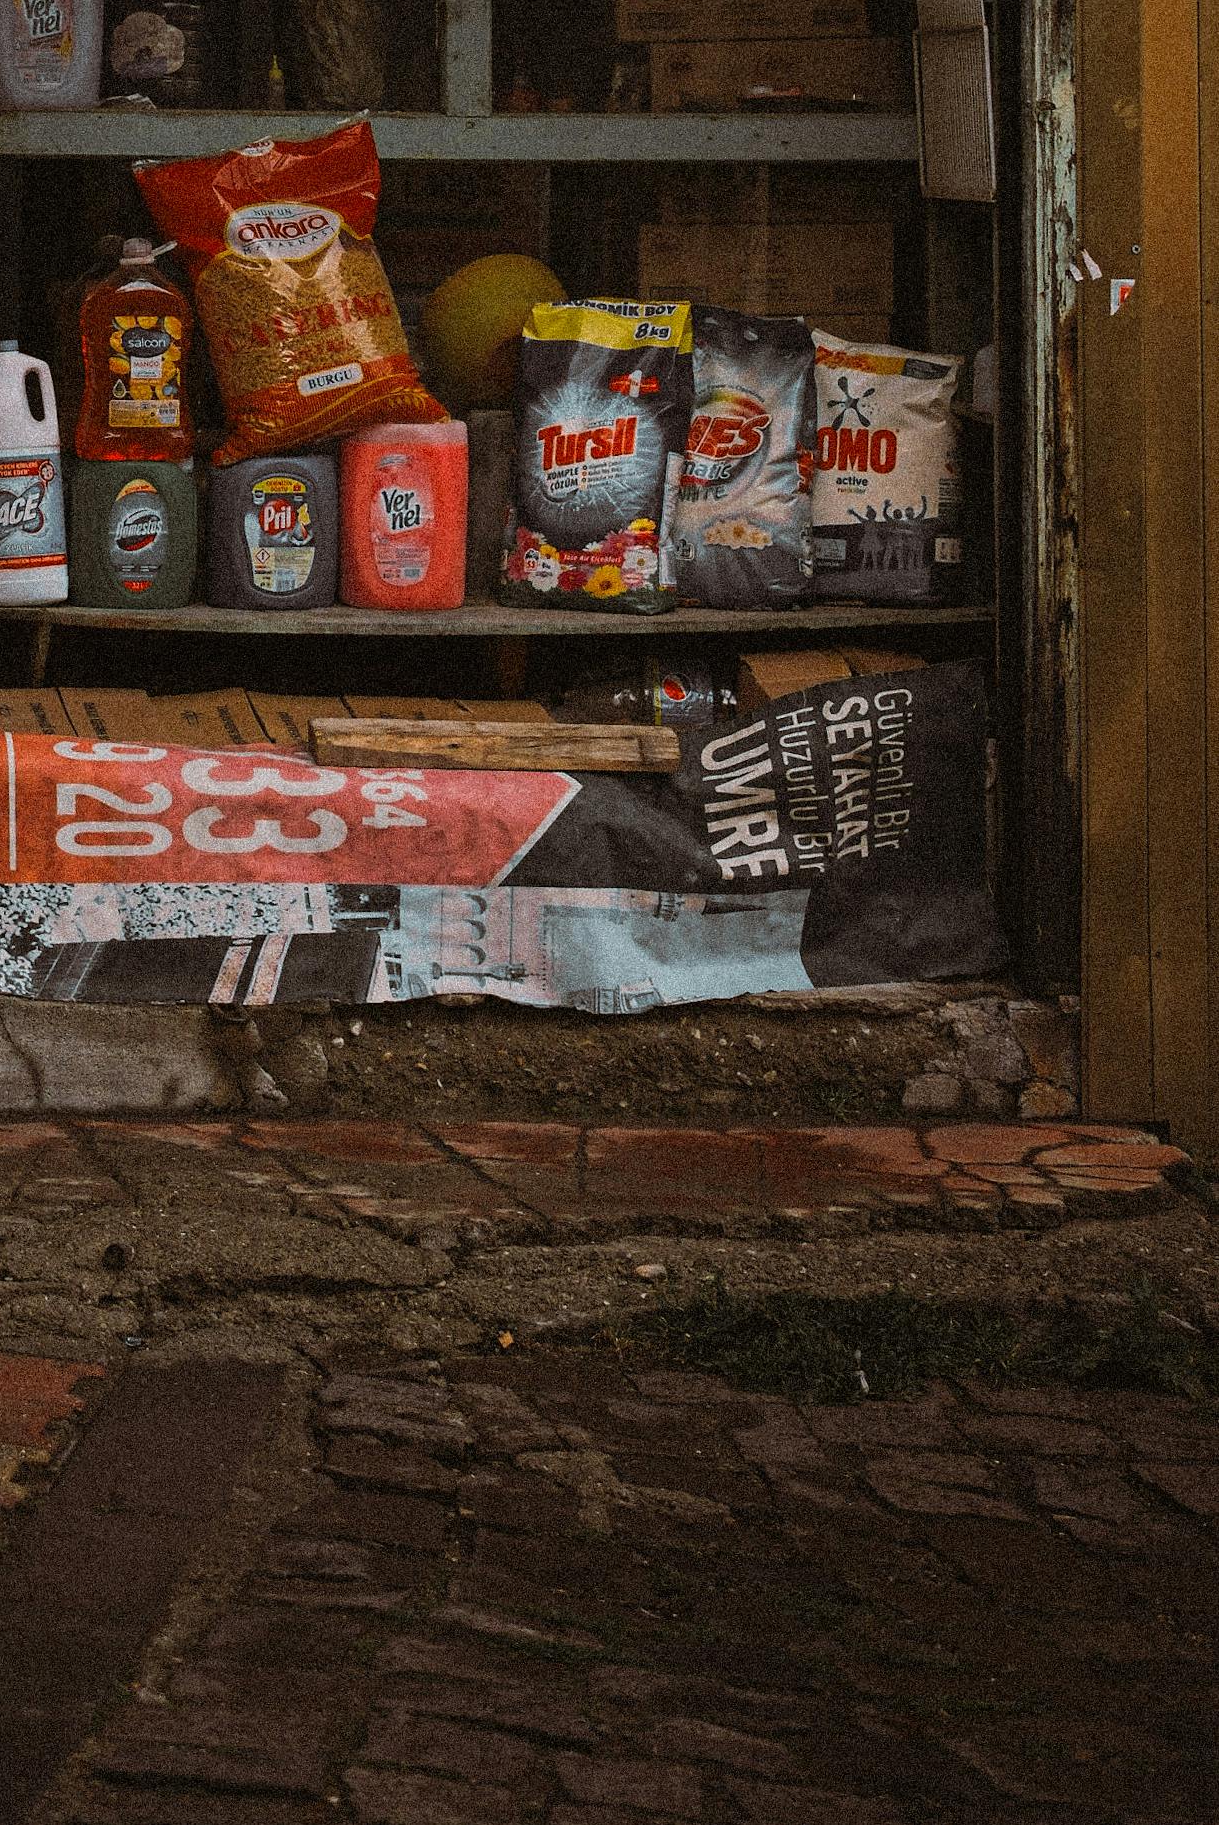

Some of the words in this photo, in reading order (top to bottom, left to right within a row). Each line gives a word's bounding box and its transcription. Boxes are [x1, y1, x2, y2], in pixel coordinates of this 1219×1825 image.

[32, 10, 60, 36] nel
[238, 214, 329, 243] ankara
[644, 303, 677, 317] BOY
[128, 337, 166, 348] saloon
[307, 369, 354, 391] BURGU
[816, 427, 898, 474] OMO
[547, 466, 578, 481] KOMPLE
[836, 476, 868, 486] active
[382, 489, 414, 514] Ver
[264, 506, 292, 531] Pril
[392, 504, 420, 530] nel
[874, 688, 914, 808] Güvenli
[775, 706, 829, 822] Huzurlu
[822, 695, 873, 861] SEYAHAT
[700, 720, 790, 881] UMRE
[874, 809, 910, 850] Bir
[793, 832, 839, 874] Bir
